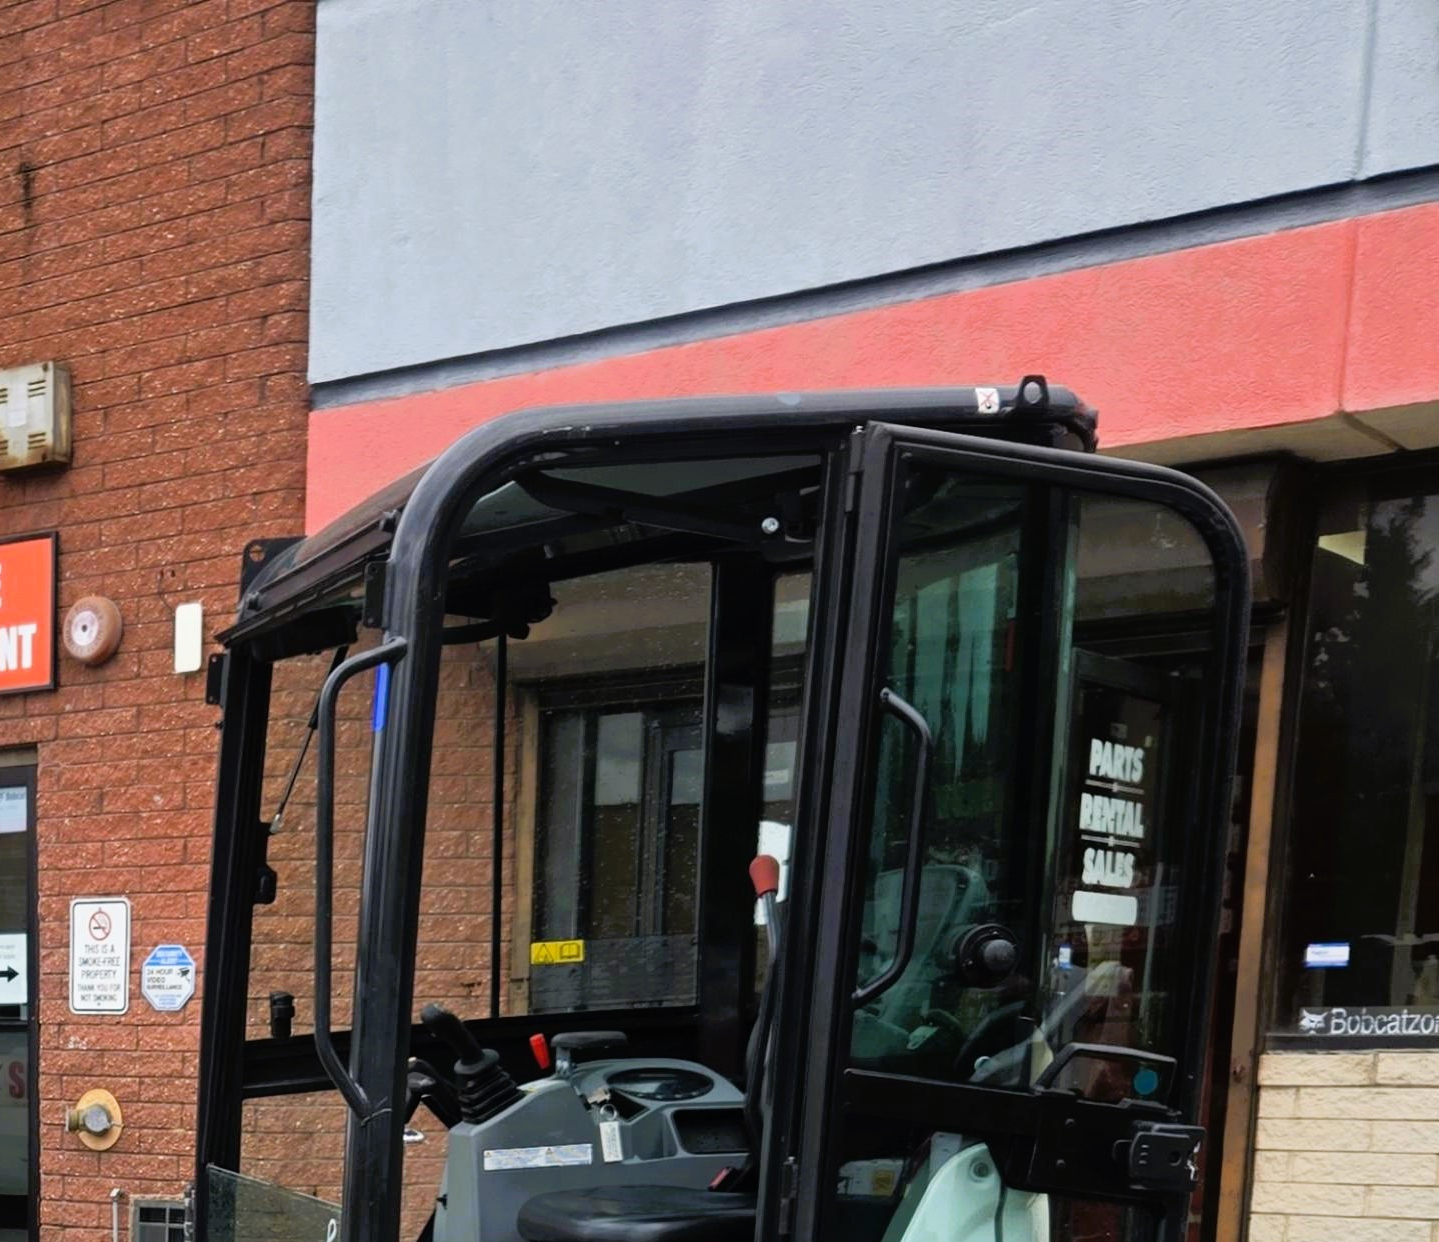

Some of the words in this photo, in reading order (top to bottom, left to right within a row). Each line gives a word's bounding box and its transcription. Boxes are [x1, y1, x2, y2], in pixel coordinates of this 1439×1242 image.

[1088, 738, 1146, 784] PARTS
[1078, 792, 1145, 839] RENTAL
[1081, 847, 1136, 888] SALES
[84, 944, 99, 954] THIS
[101, 944, 108, 954] IS
[78, 956, 121, 967] SMOKE-FREE
[81, 969, 117, 979] PROPERTY
[147, 976, 166, 984] VIDEO
[77, 984, 95, 992] THANK
[97, 984, 108, 992] YOU
[110, 983, 121, 992] FOR
[81, 994, 92, 1002] NOT
[93, 993, 118, 1002] SMOKING
